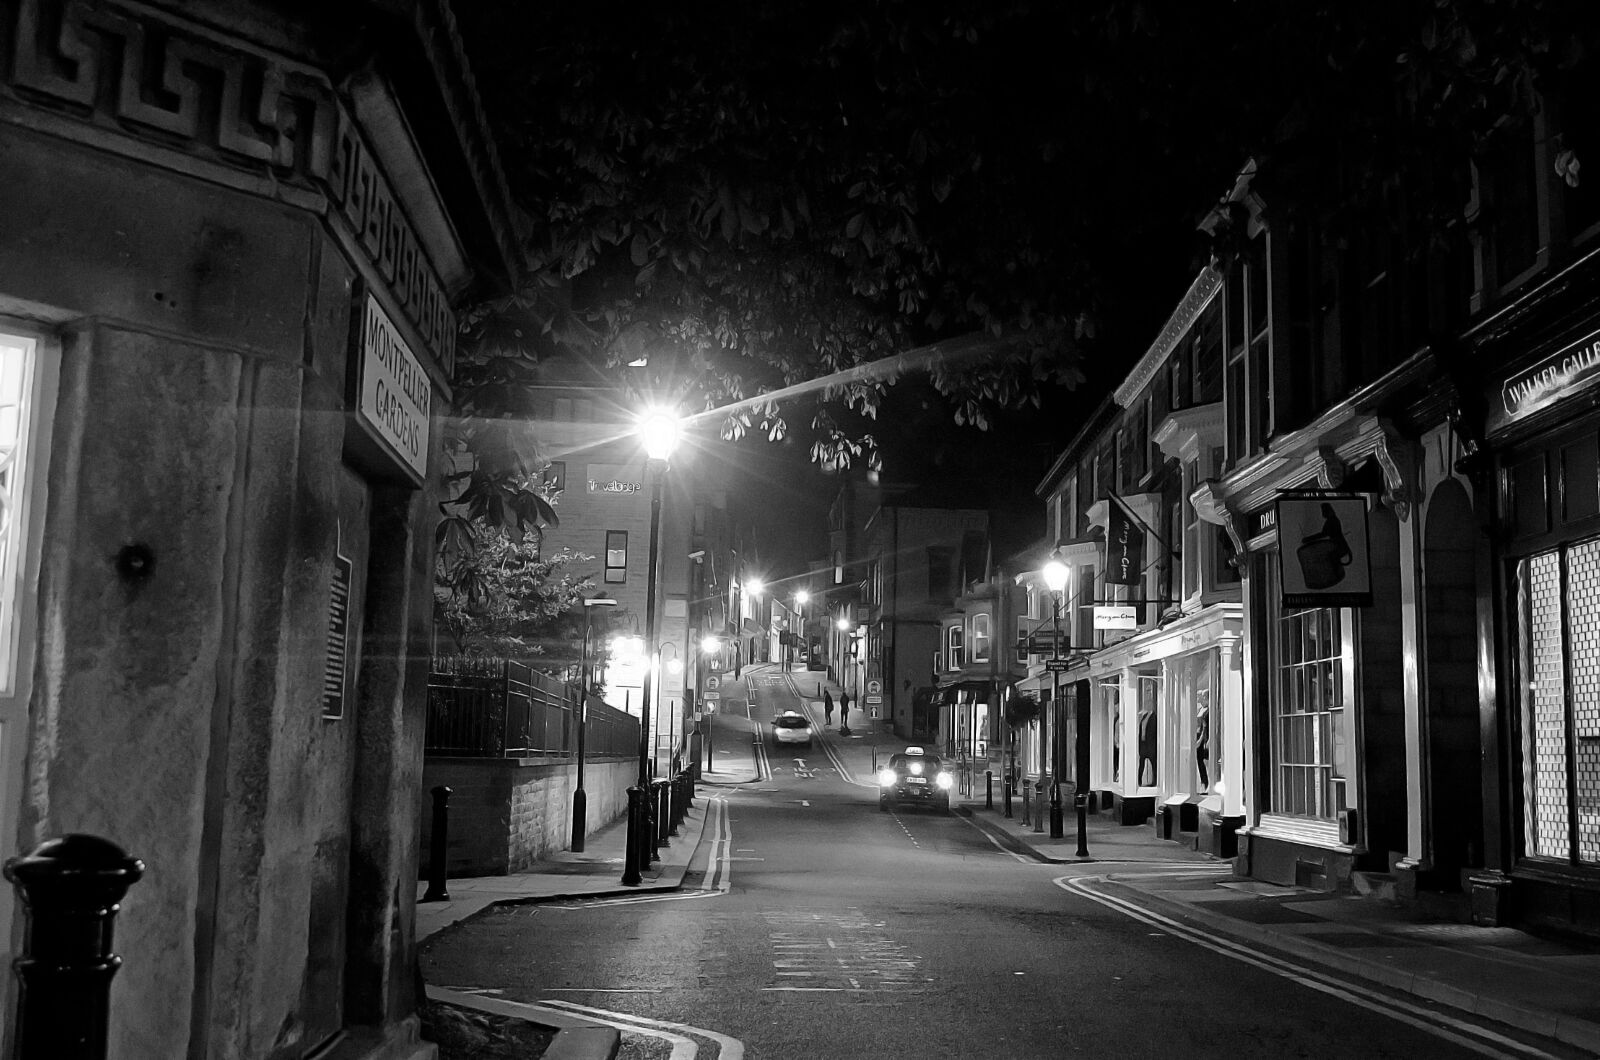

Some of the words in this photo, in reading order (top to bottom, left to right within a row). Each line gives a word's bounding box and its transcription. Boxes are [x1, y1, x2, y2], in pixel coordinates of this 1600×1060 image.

[367, 307, 429, 420] MONTPELLIER
[1508, 365, 1557, 404] WALKER
[376, 378, 419, 458] GARDENS
[588, 479, 641, 495] Trvelodge
[1260, 509, 1275, 530] DRU
